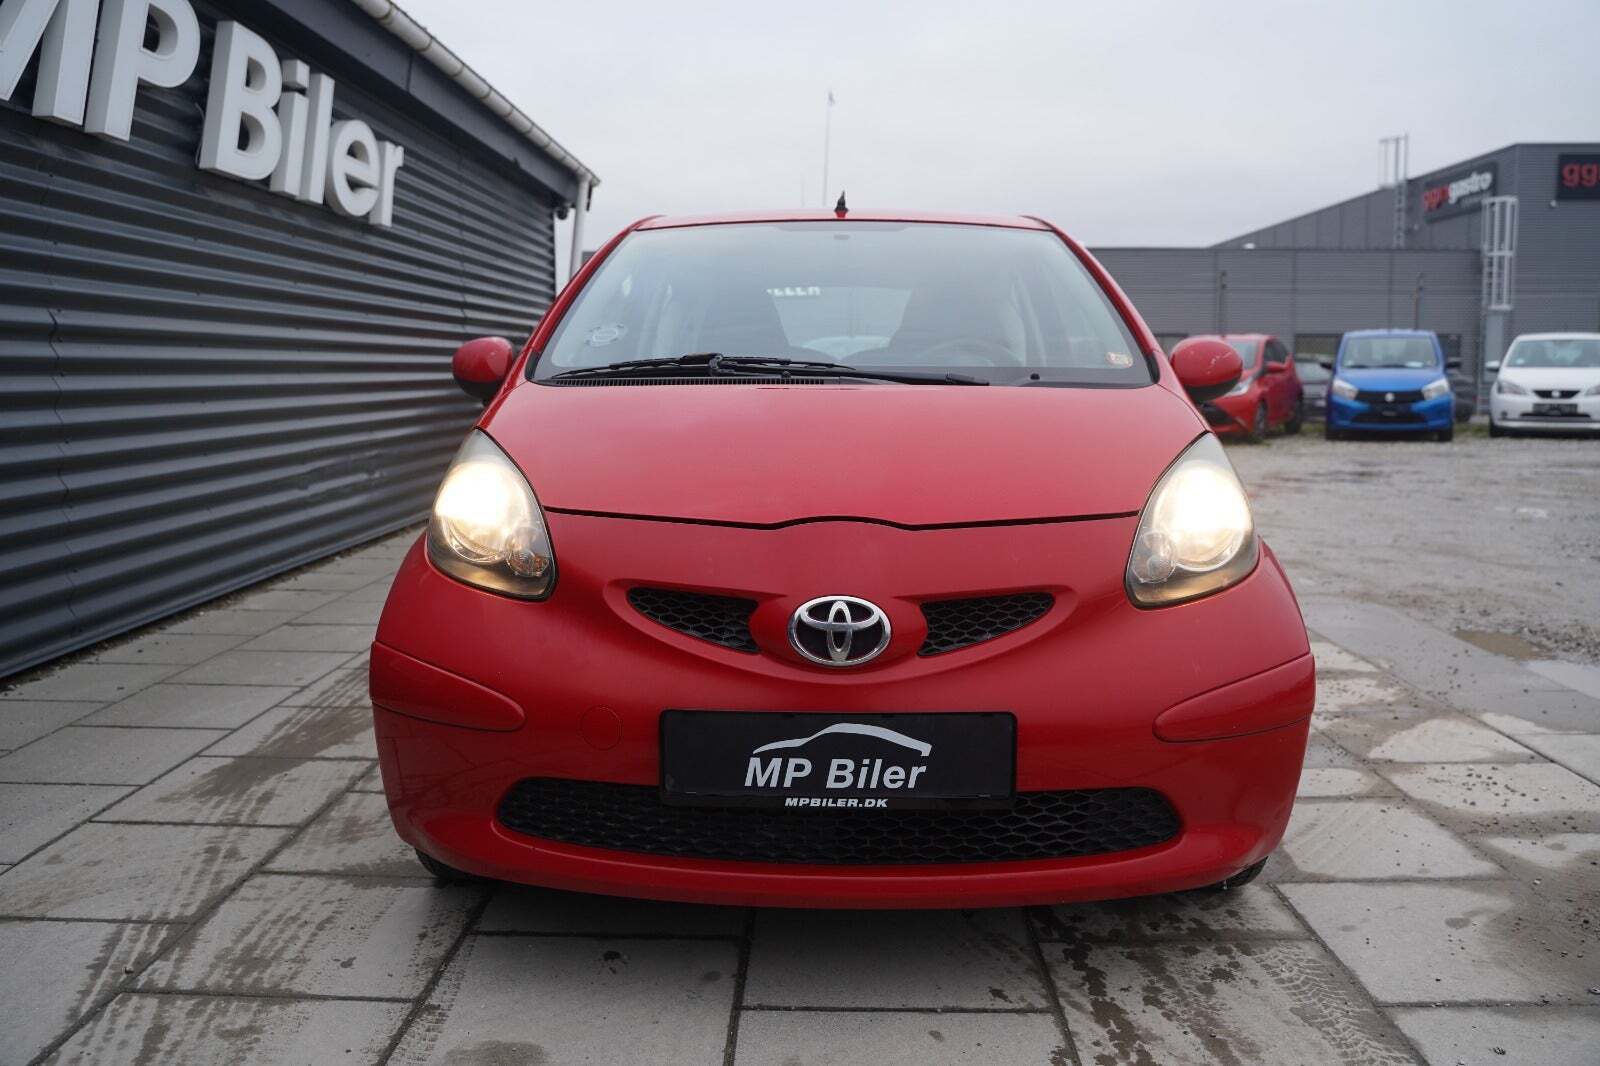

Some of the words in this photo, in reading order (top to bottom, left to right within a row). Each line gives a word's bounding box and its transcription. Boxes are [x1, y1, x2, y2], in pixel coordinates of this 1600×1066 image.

[200, 21, 404, 226] Biler
[1562, 163, 1600, 187] gg
[744, 757, 812, 788] MP
[826, 758, 926, 789] Biler
[784, 797, 888, 808] MPBILER.DK
